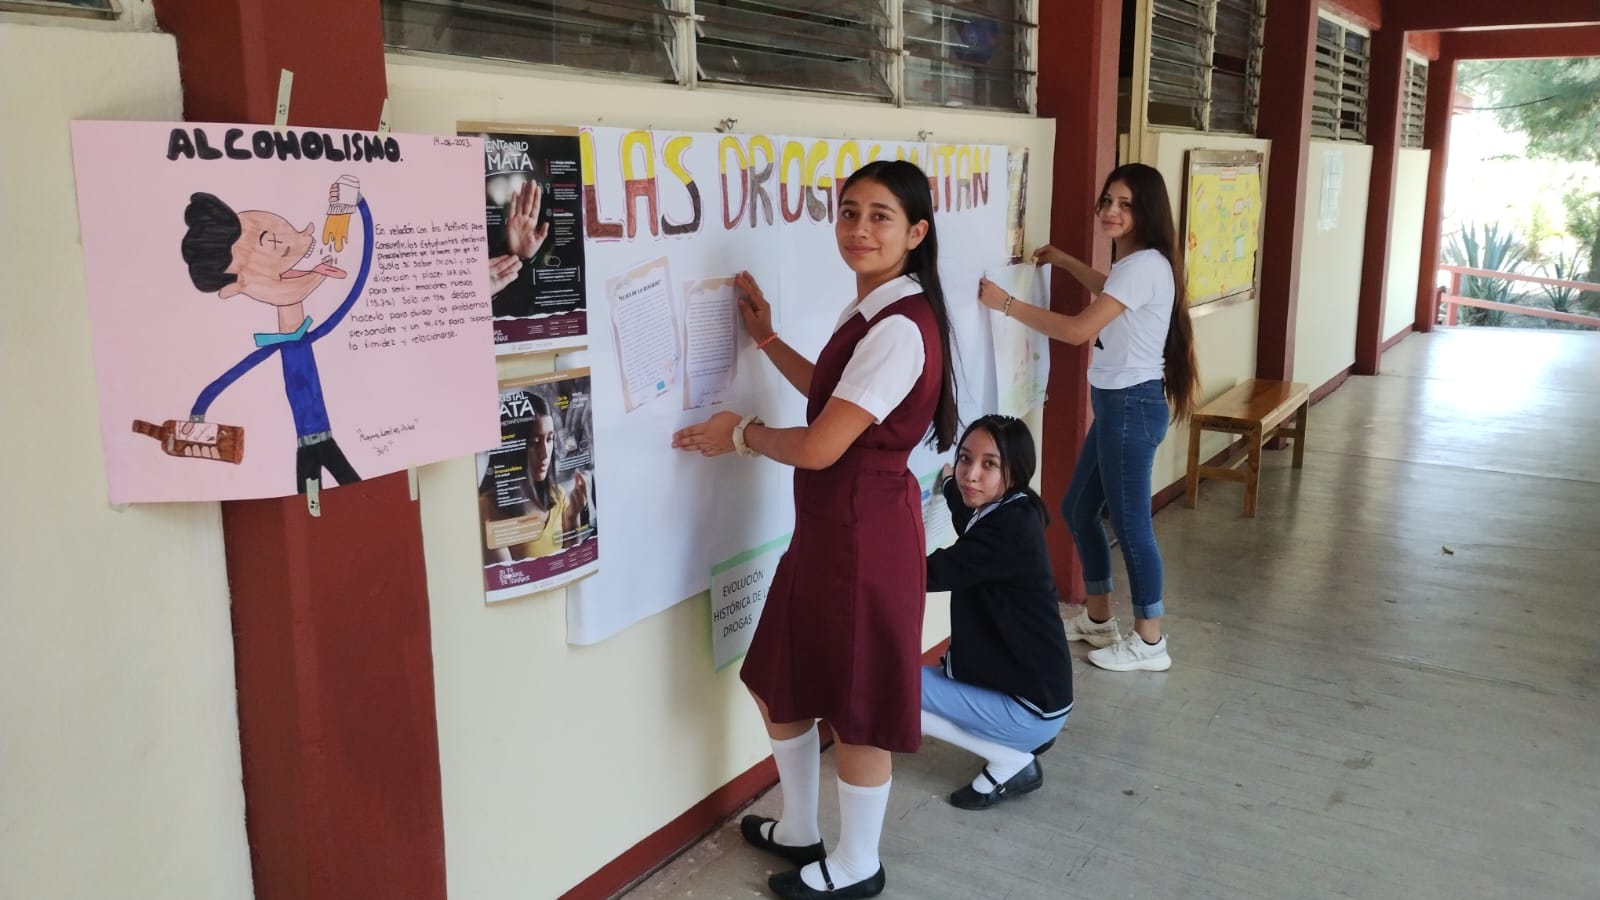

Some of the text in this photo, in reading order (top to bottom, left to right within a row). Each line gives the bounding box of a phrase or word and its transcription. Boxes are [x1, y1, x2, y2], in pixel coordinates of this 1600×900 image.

[485, 139, 529, 153] ENTANILO
[487, 153, 534, 171] MATA
[580, 129, 700, 238] LAS
[375, 224, 385, 235] En
[369, 287, 387, 297] para
[351, 311, 384, 323] hacerlo
[390, 312, 408, 321] para
[349, 325, 397, 338] personales
[348, 341, 358, 351] la
[365, 338, 396, 349] timidez
[499, 391, 529, 403] ISTAL
[499, 399, 536, 418] ATA
[722, 568, 764, 598] EVOLUCIÓN
[713, 594, 752, 622] HISTÓRICA
[752, 580, 762, 604] DE
[723, 613, 753, 638] DROGAS
